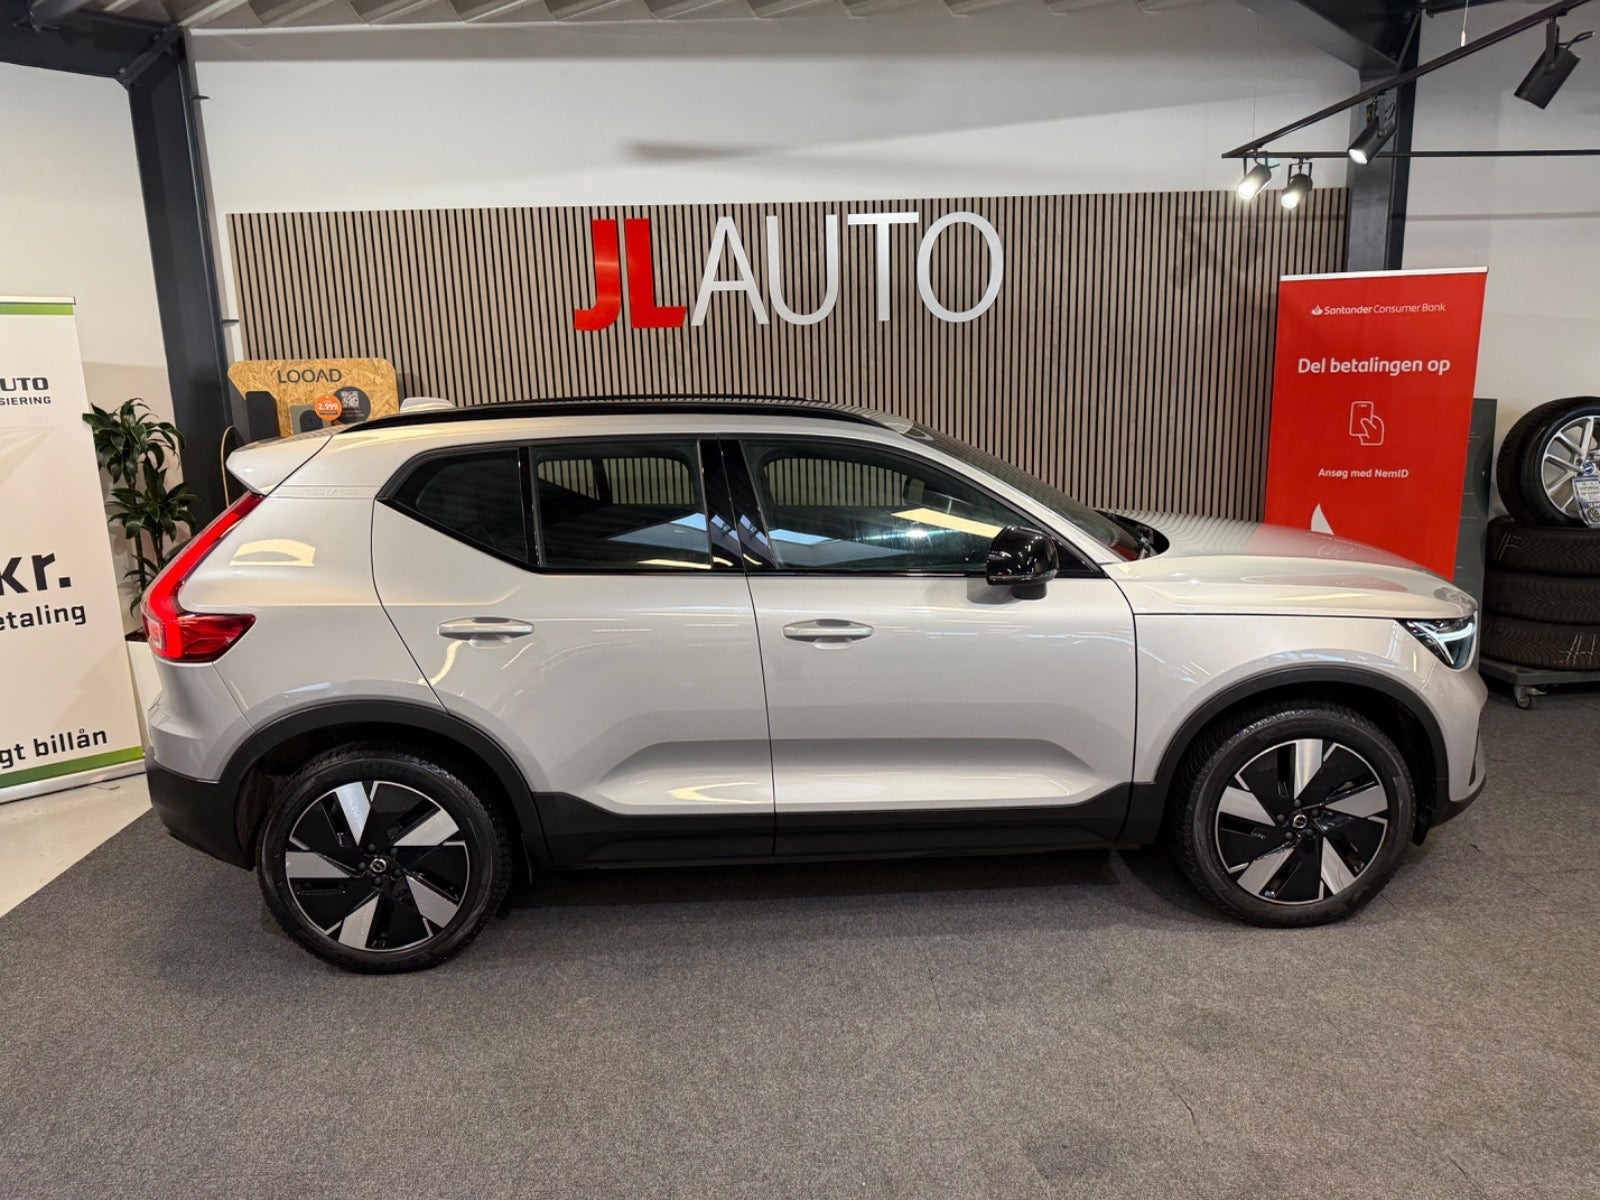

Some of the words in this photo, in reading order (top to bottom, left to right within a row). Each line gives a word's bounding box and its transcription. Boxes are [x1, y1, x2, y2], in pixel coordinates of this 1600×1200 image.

[1324, 305, 1372, 316] Santander
[1373, 303, 1421, 314] Consumer
[1422, 303, 1446, 313] Bank
[1297, 357, 1326, 375] Del
[1330, 356, 1423, 376] betalingen
[1427, 358, 1450, 376] op
[277, 368, 343, 384] LOOAD
[1318, 468, 1348, 480] Ansøg
[1350, 468, 1372, 479] med
[1374, 468, 1409, 479] NemID
[33, 728, 108, 757] billån
